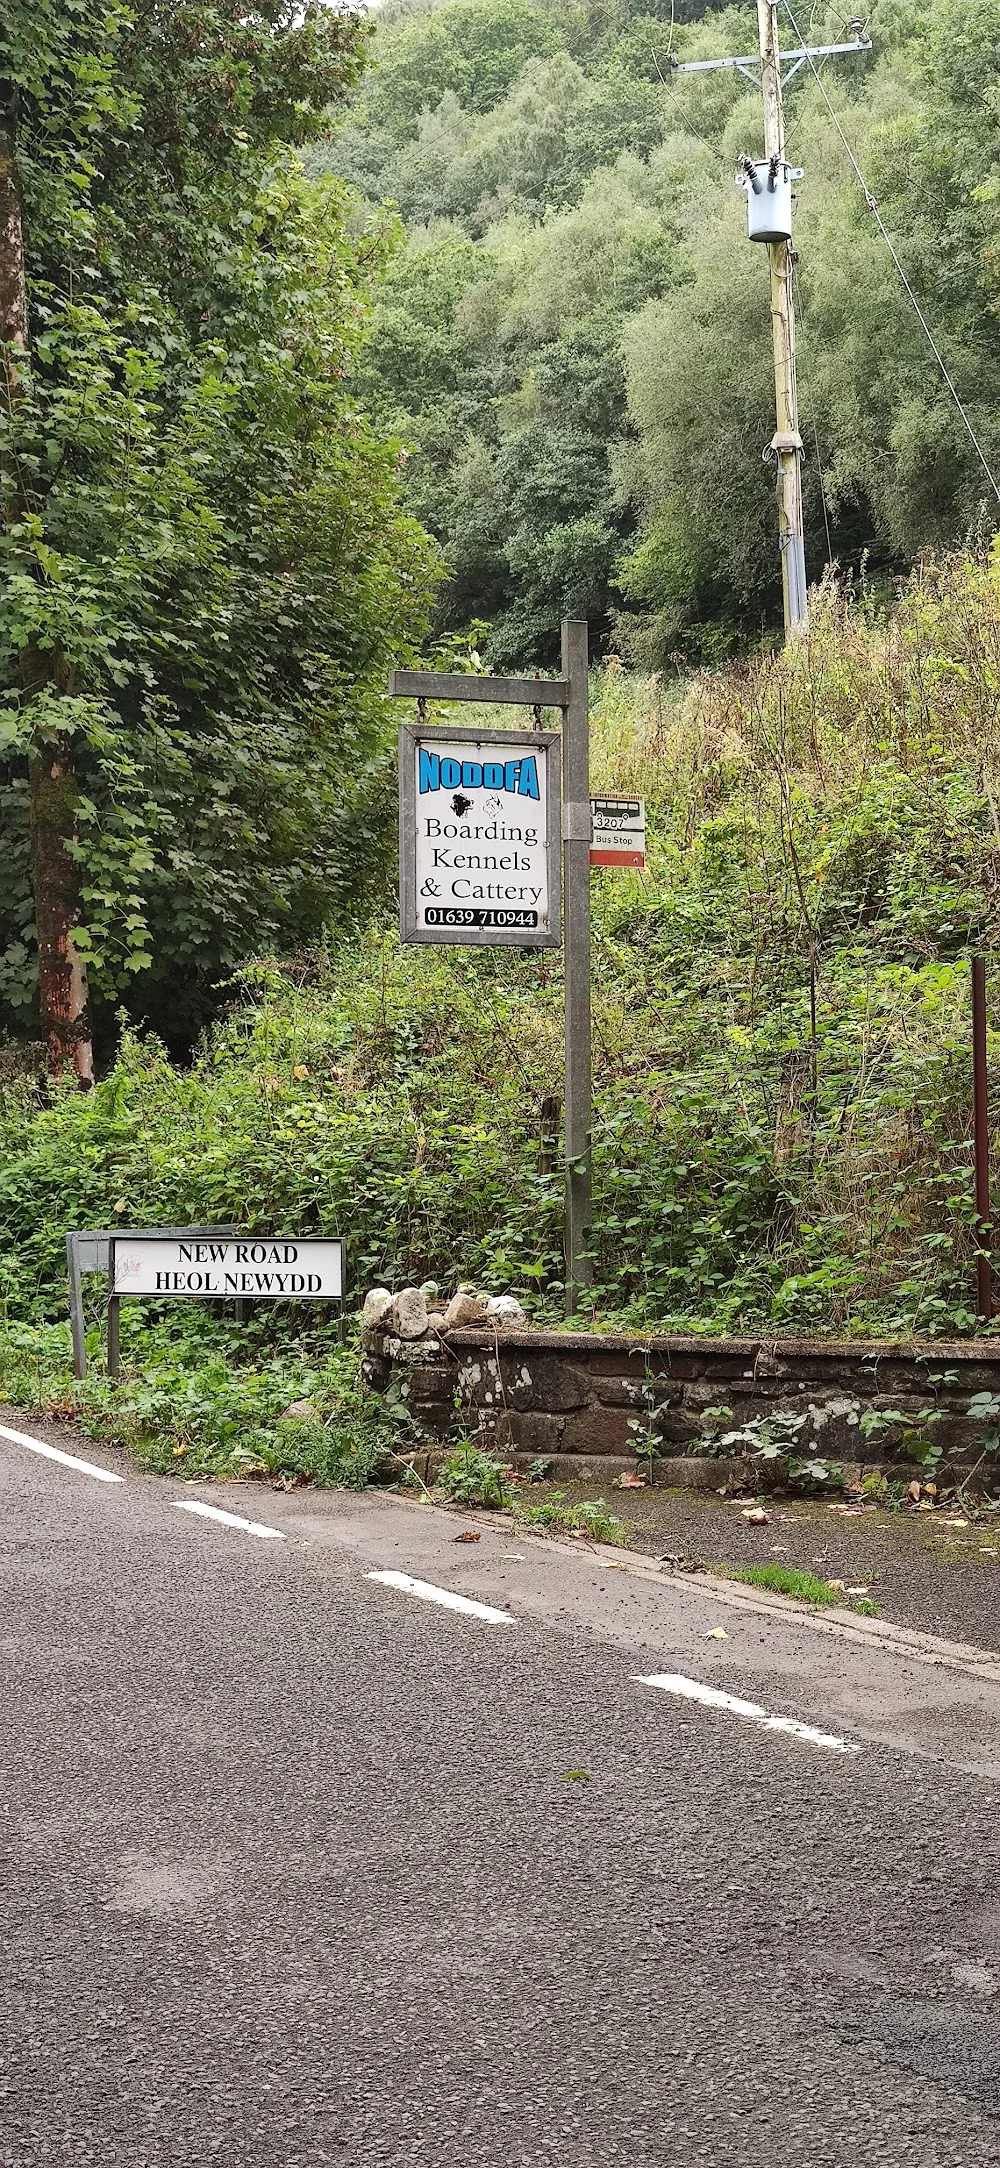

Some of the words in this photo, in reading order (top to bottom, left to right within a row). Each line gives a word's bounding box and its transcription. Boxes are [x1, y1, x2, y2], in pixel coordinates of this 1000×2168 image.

[419, 748, 540, 801] NODDFA
[424, 818, 538, 846] Boarding
[596, 817, 624, 828] 3207
[596, 835, 611, 844] Bus
[613, 836, 633, 846] Stop
[431, 848, 531, 871] Kennels
[420, 877, 442, 897] &
[451, 879, 544, 905] Cattery
[427, 909, 474, 924] 01639
[478, 911, 535, 926] 710944
[178, 1244, 229, 1263] NEW
[235, 1244, 298, 1264] ROAD
[155, 1271, 217, 1291] HEOL
[223, 1272, 322, 1293] NEWYDD
